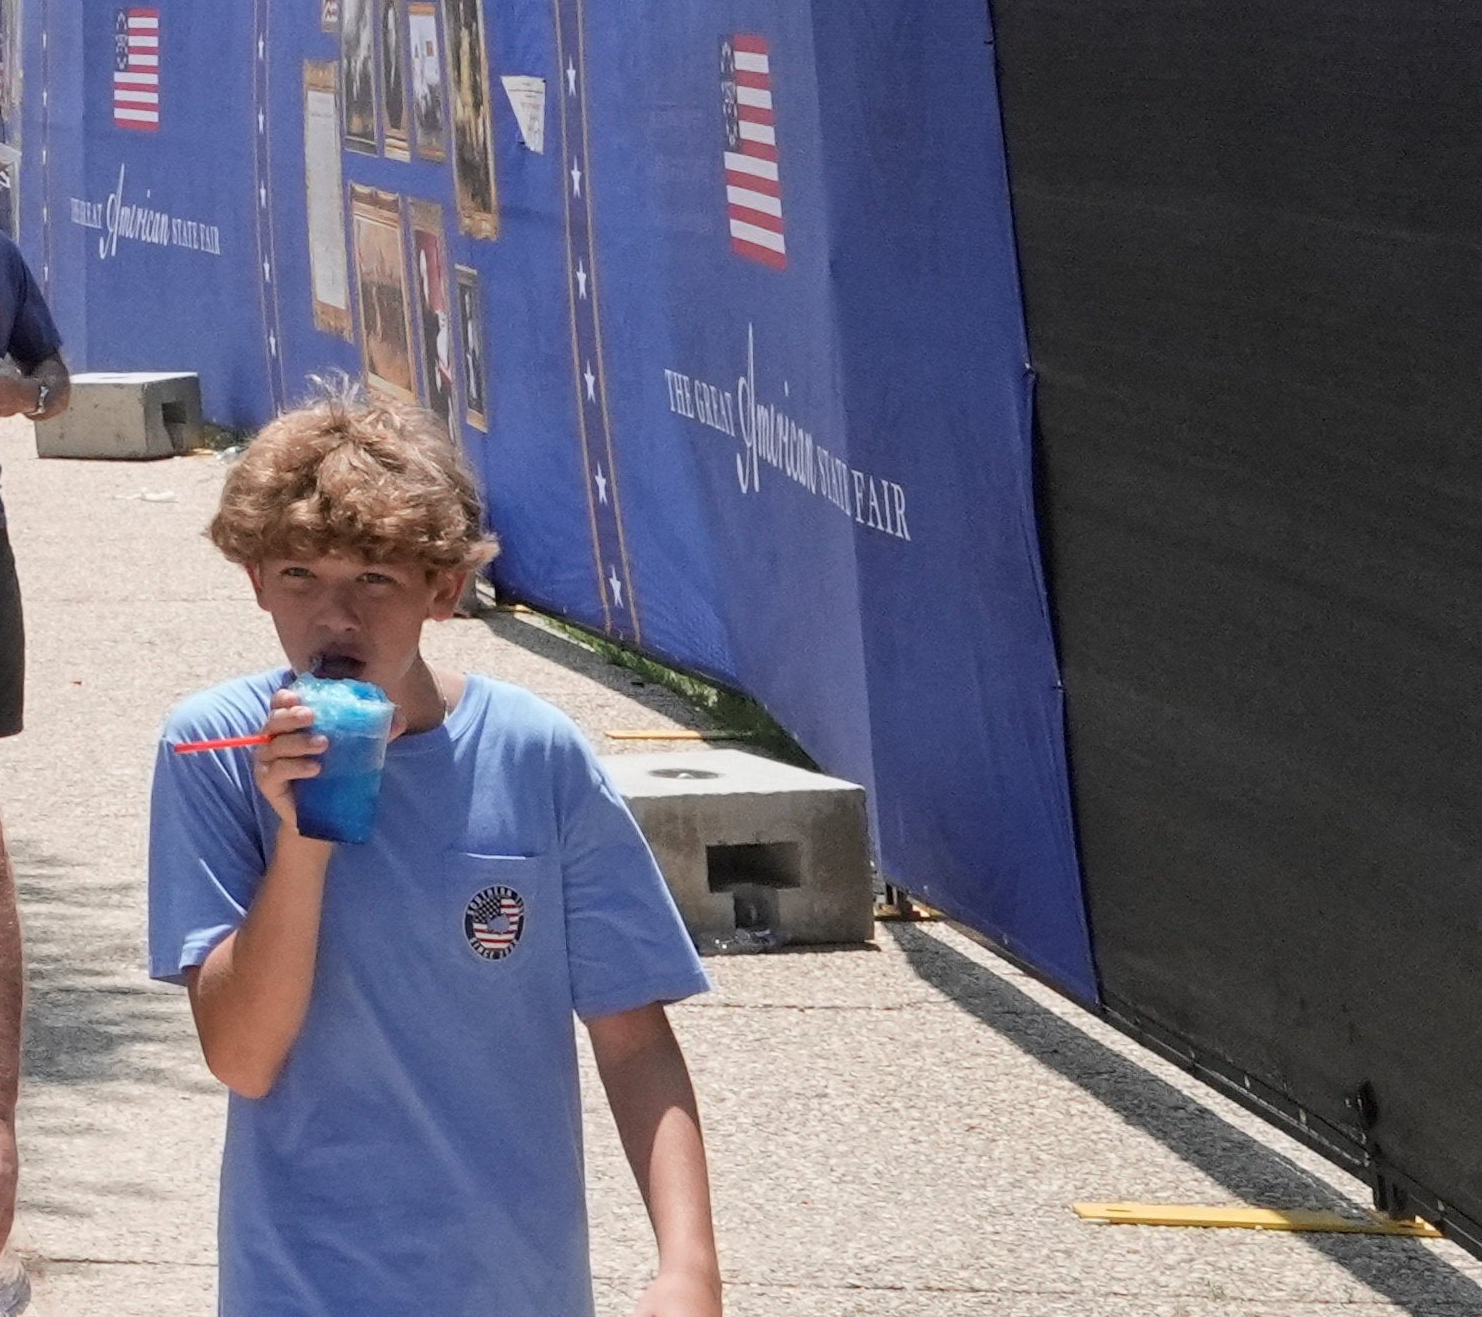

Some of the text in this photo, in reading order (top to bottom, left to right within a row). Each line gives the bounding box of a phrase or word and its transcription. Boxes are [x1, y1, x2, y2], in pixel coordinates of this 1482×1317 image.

[99, 163, 170, 259] American
[171, 217, 199, 250] STATE
[198, 223, 221, 256] FAIR
[664, 322, 912, 542] THE GREAT American STATE FAIR
